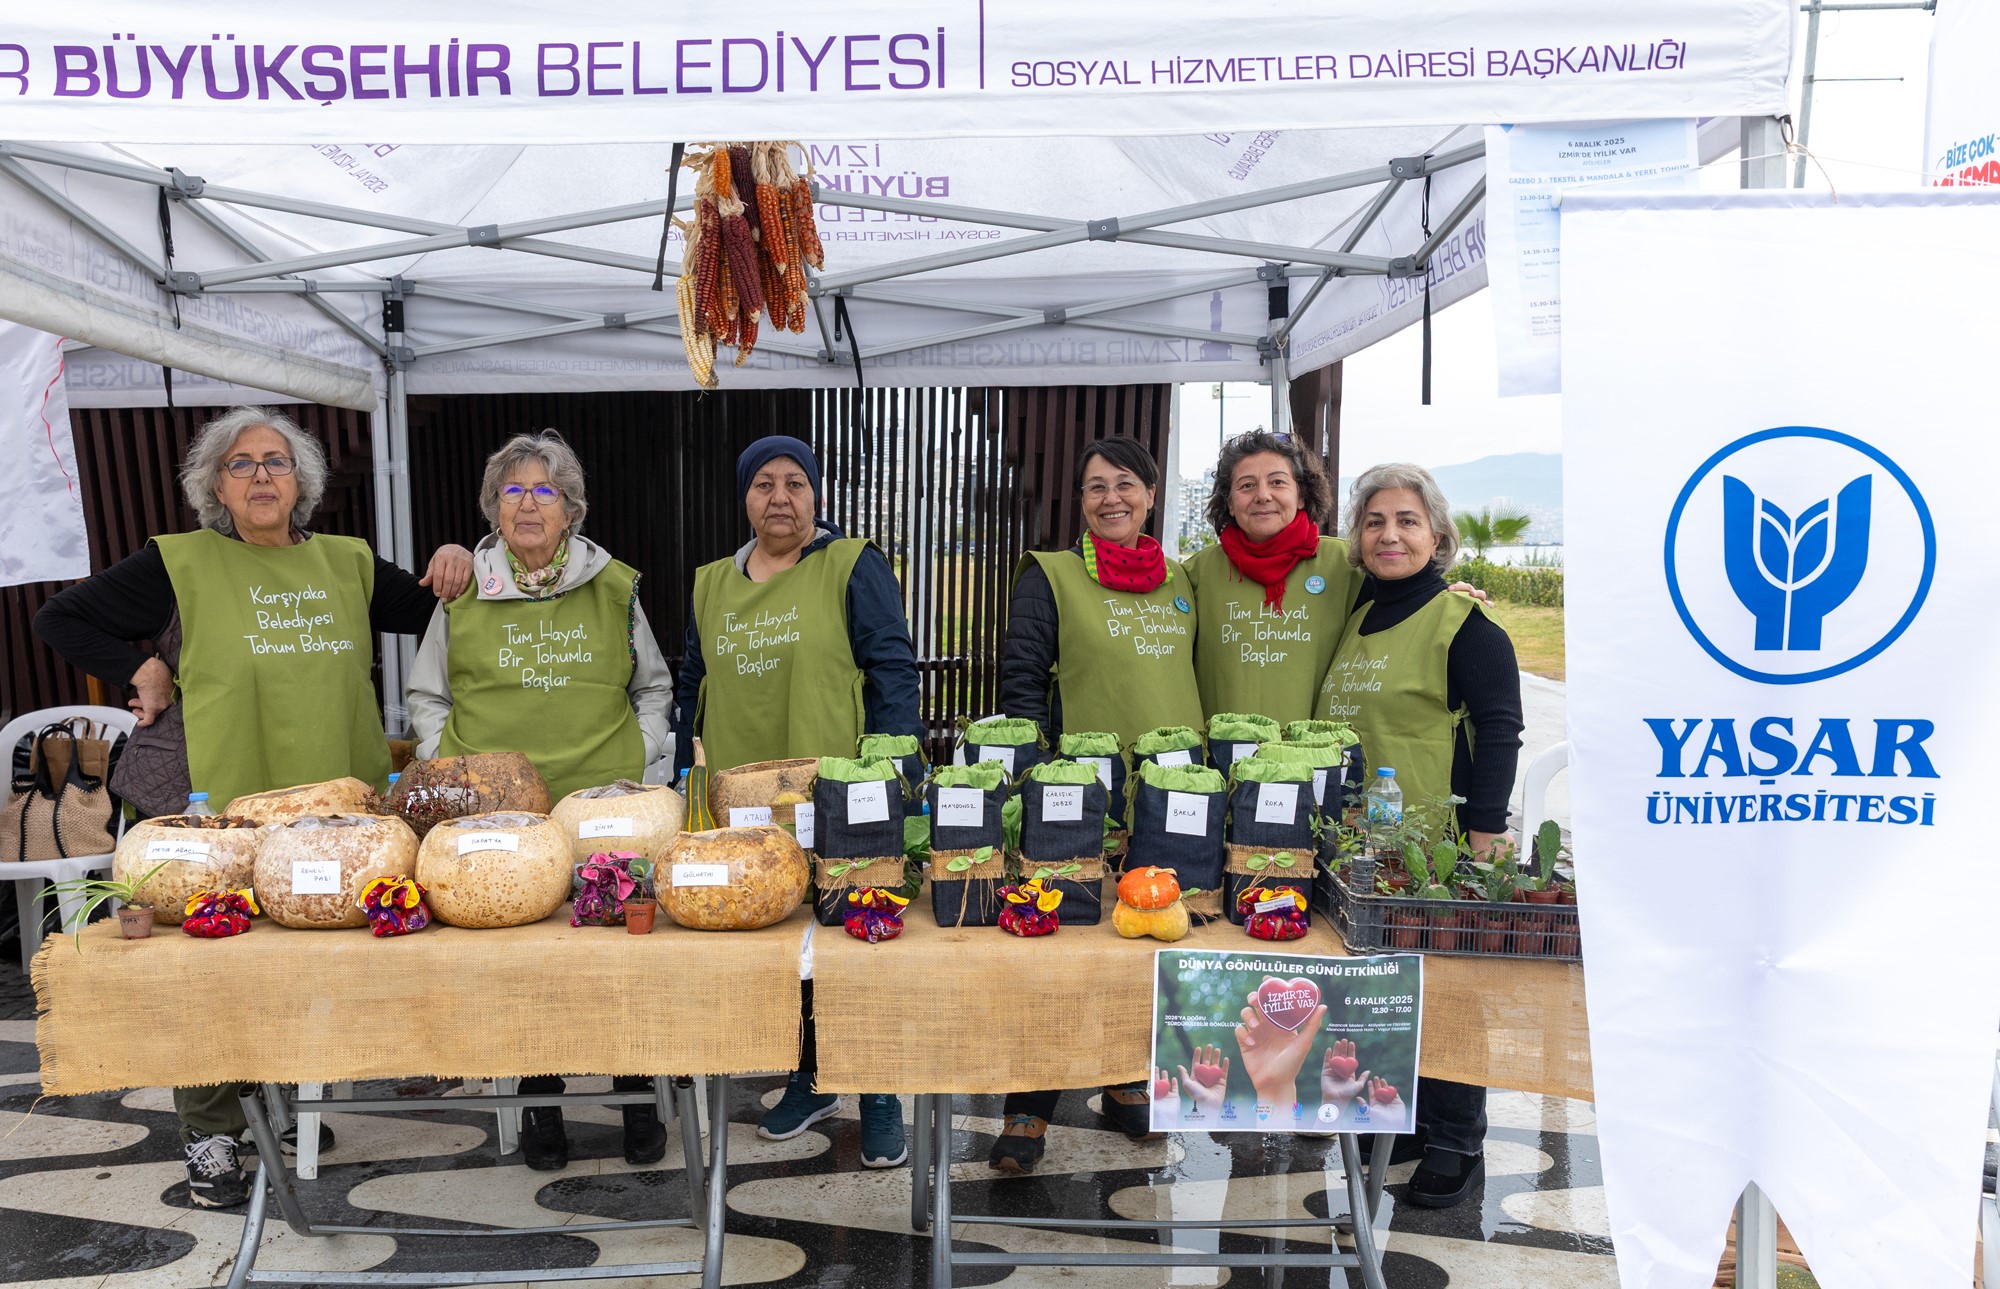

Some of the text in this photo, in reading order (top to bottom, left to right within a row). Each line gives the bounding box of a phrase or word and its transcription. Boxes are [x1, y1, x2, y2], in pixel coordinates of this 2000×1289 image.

[54, 34, 511, 106] BÜYÜKŞEHİR
[538, 27, 944, 96] BELEDİYESİ
[1012, 39, 1685, 86] SOSYAL HİZMETLER DAİRESİ BAŞKANLIĞI
[1604, 137, 1625, 146] 2025
[1946, 133, 1995, 169] BİZE ÇOK
[1549, 175, 1577, 183] TEKSTİL
[1586, 172, 1624, 181] MANDALA
[1634, 168, 1658, 177] YEREL
[250, 584, 328, 608] Karşıyaka
[1104, 599, 1133, 616] Tüm
[256, 609, 334, 633] Belediyesi
[723, 605, 799, 632] Tüm Hayat
[1226, 601, 1251, 621] Tüm
[502, 620, 588, 647] Tüm Hayat
[1107, 616, 1187, 637] Bir Tohumla
[1222, 621, 1311, 644] Bir Tohumla
[243, 634, 354, 654] Tohum Bohçası
[717, 625, 800, 655] Bir Tohumla
[1134, 636, 1175, 659] Başlar
[499, 643, 592, 667] Bir Tohumla
[736, 652, 780, 677] Başlar
[1241, 643, 1287, 667] Başlar
[522, 667, 571, 692] Başlar
[1341, 672, 1382, 692] Tohumla
[1330, 695, 1361, 720] Başlar
[1643, 716, 1941, 785] YAŞAR
[1173, 808, 1196, 816] BAKLA
[1646, 789, 1937, 826] ÜNİVERSİTESİ
[1178, 957, 1399, 976] DÜNYA GÖNÜLLÜLER GÜNÜ ETKİNLİĞİ
[1263, 999, 1316, 1013] İYİLİK VAR
[1268, 990, 1311, 1002] İZMİR'DE
[1344, 995, 1413, 1005] 6 ARALIK 2025
